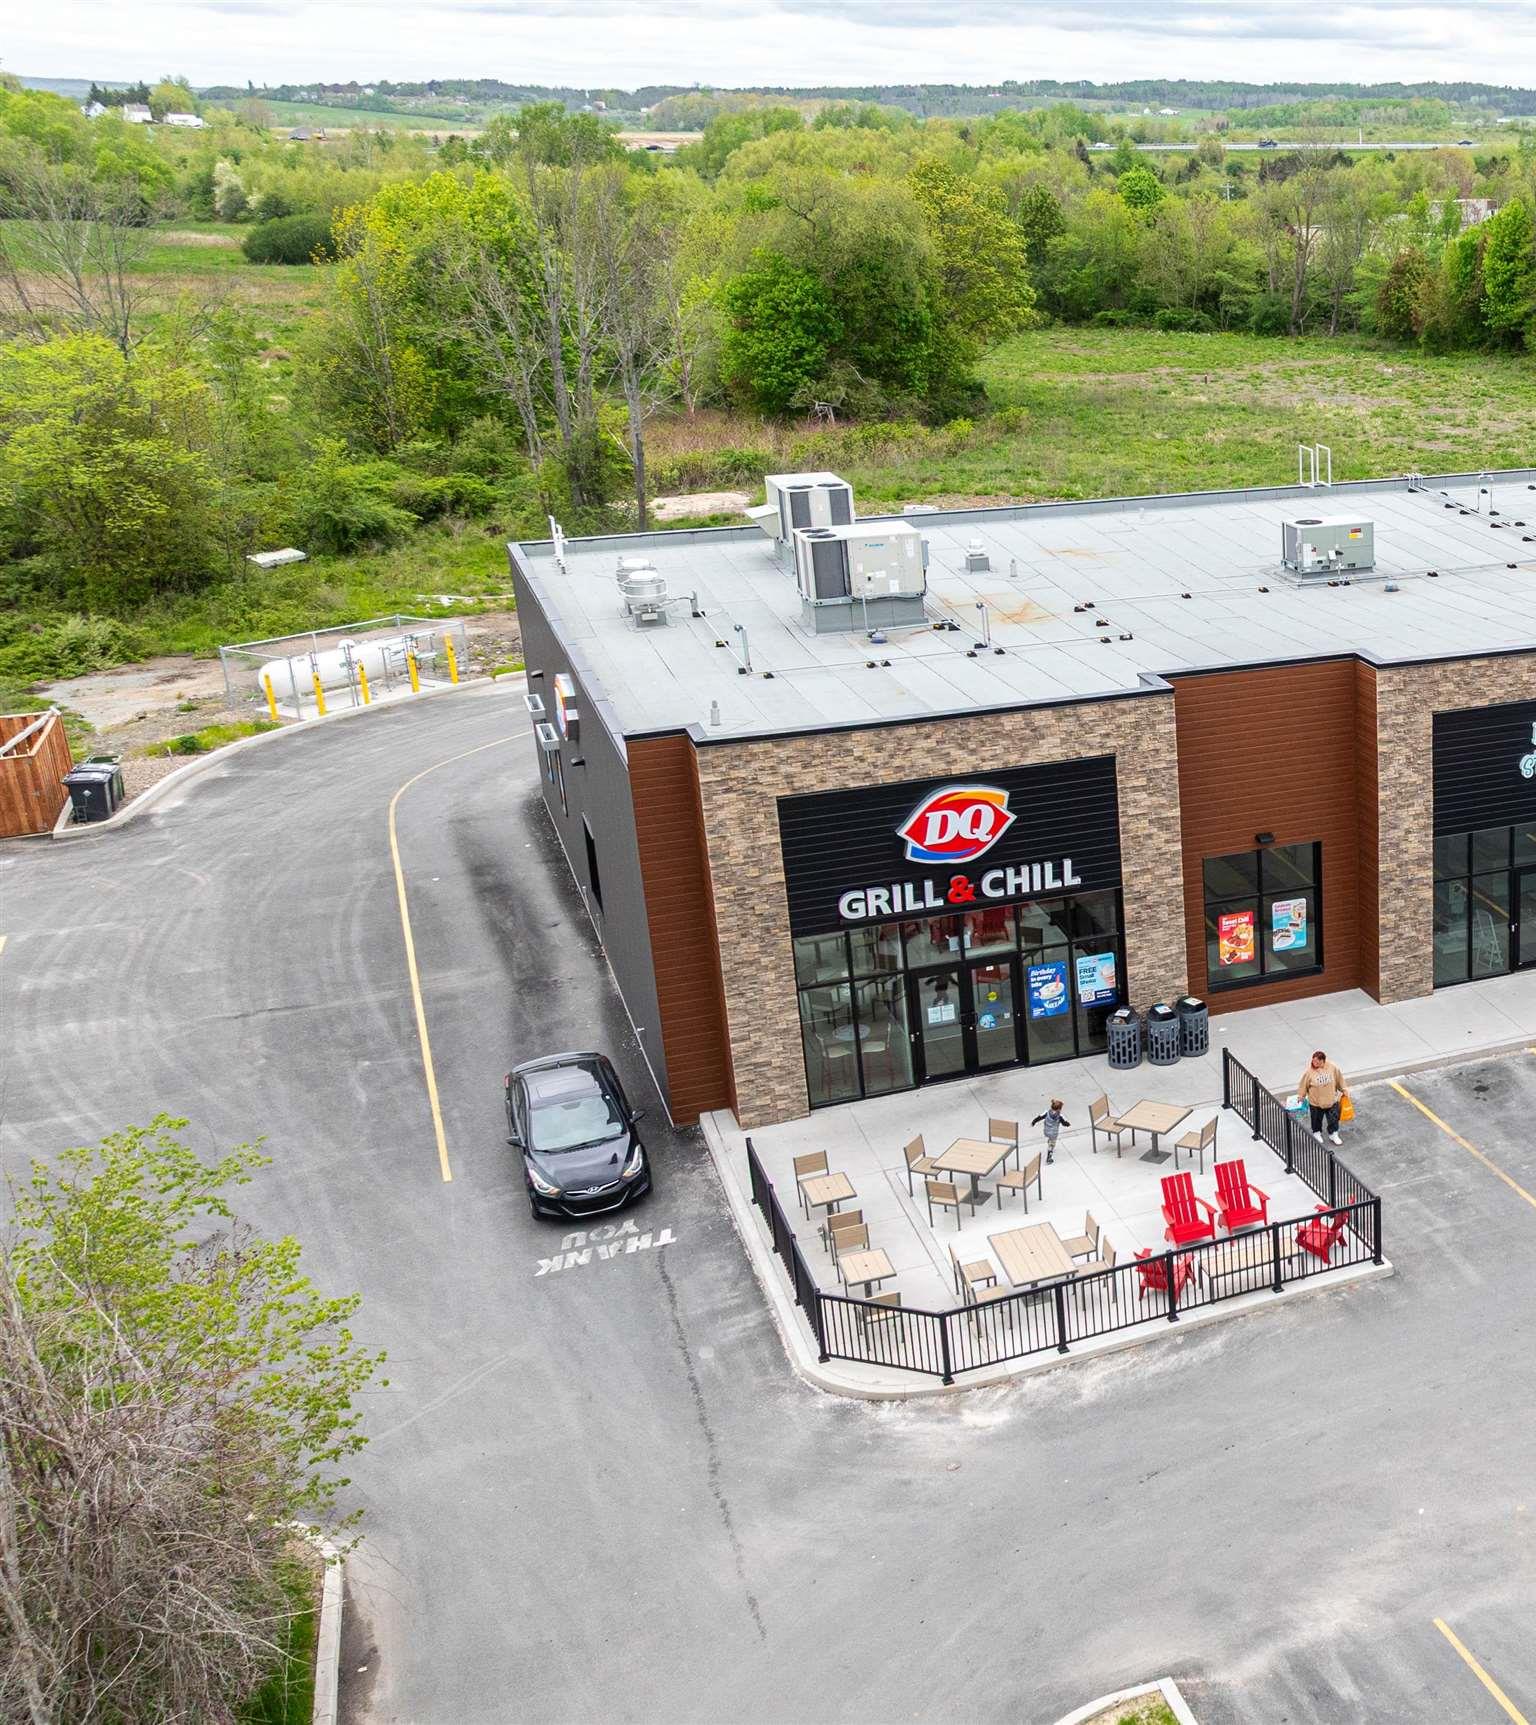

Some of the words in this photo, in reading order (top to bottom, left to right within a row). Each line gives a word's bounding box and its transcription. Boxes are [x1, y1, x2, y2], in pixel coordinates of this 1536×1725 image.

[923, 804, 995, 846] DQ
[838, 879, 945, 920] GRILL
[947, 874, 976, 904] &
[981, 858, 1082, 898] CHILL
[534, 1228, 677, 1277] THANK
[561, 1219, 640, 1250] YOU
